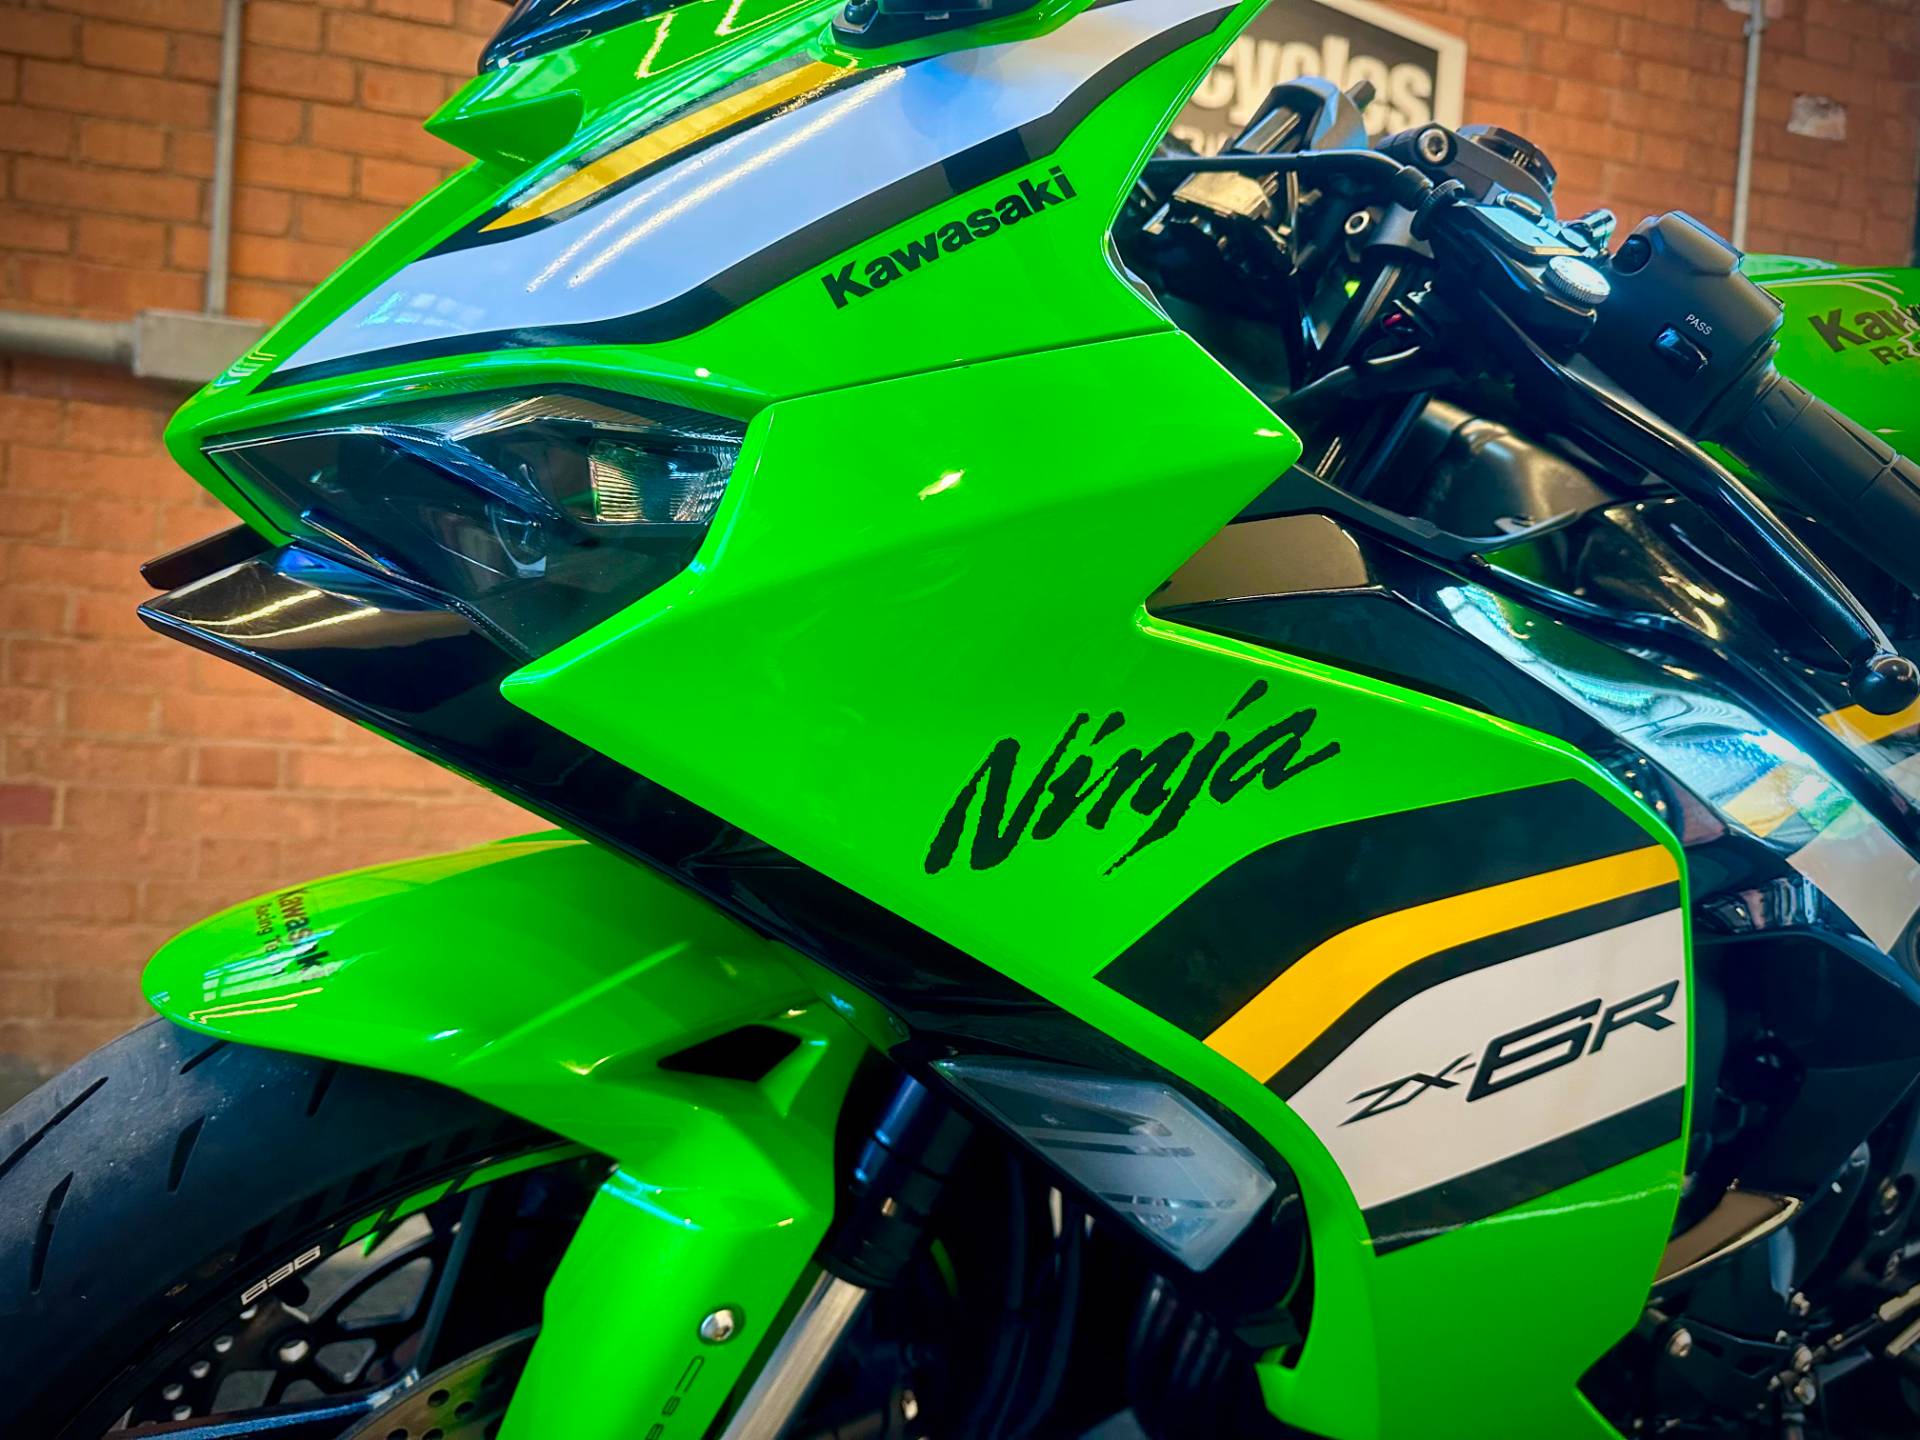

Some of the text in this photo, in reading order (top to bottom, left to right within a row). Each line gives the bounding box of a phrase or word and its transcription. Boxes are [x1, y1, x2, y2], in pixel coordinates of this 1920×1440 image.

[821, 165, 1077, 309] Kawasaki
[1685, 313, 1713, 335] PASS
[924, 679, 1341, 877] Ninja
[276, 887, 331, 980] Kawask
[1337, 979, 1680, 1128] ZX-6R
[241, 1245, 321, 1306] 636
